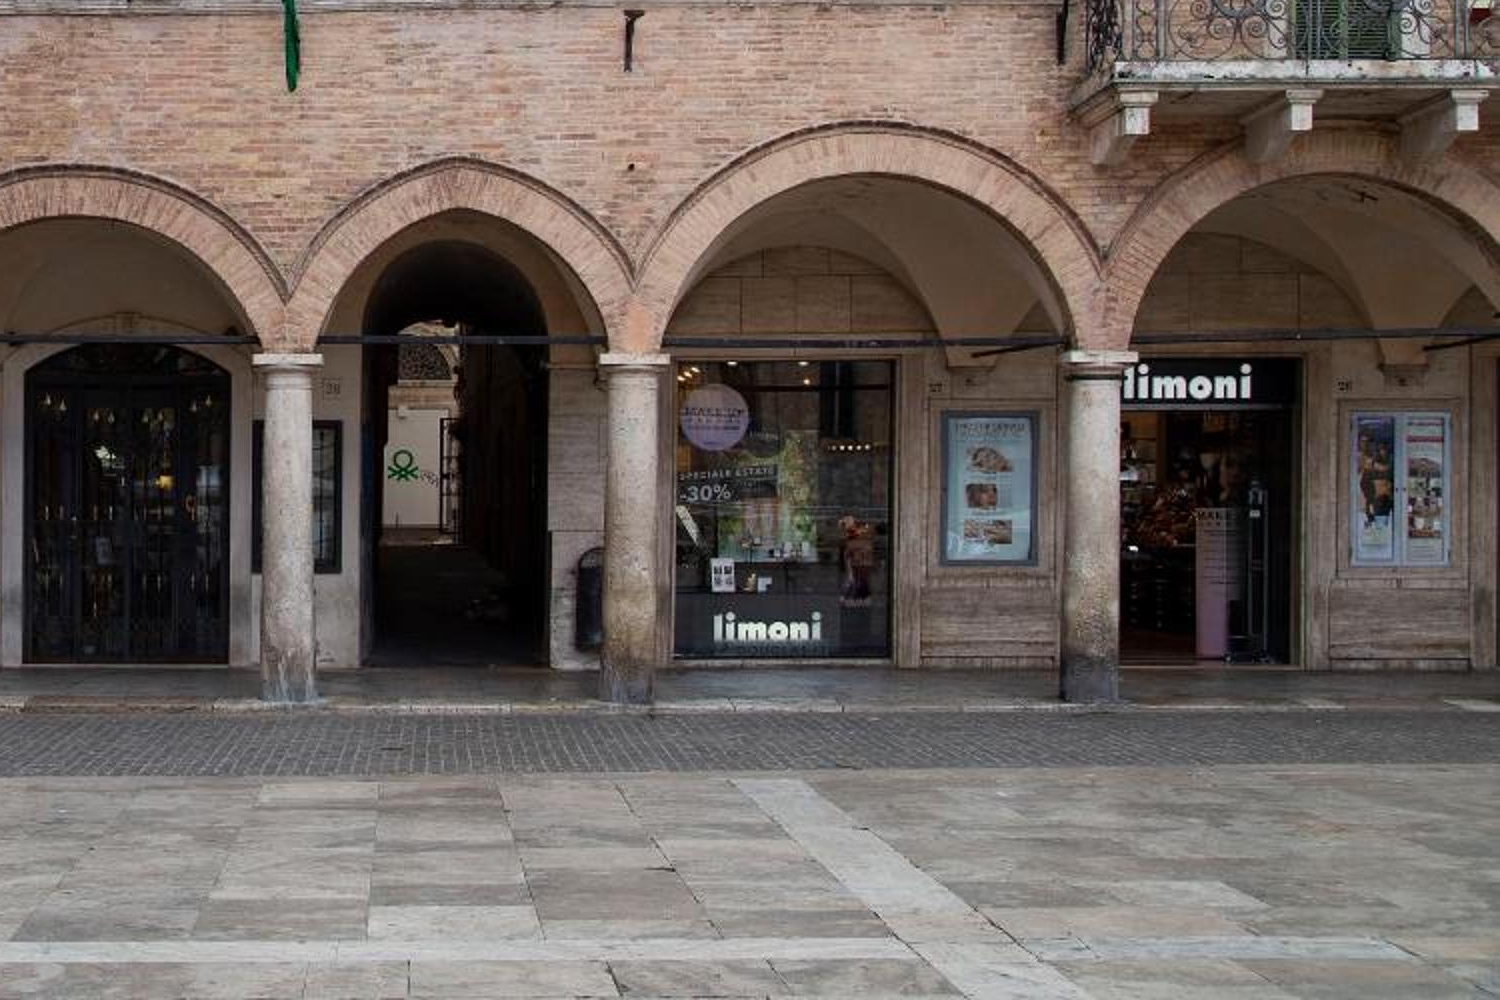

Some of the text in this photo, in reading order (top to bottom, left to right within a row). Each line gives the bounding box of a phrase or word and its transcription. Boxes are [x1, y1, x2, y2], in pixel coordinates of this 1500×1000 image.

[1123, 363, 1252, 399] limoni
[679, 483, 732, 502] -30%
[713, 611, 821, 641] limoni
